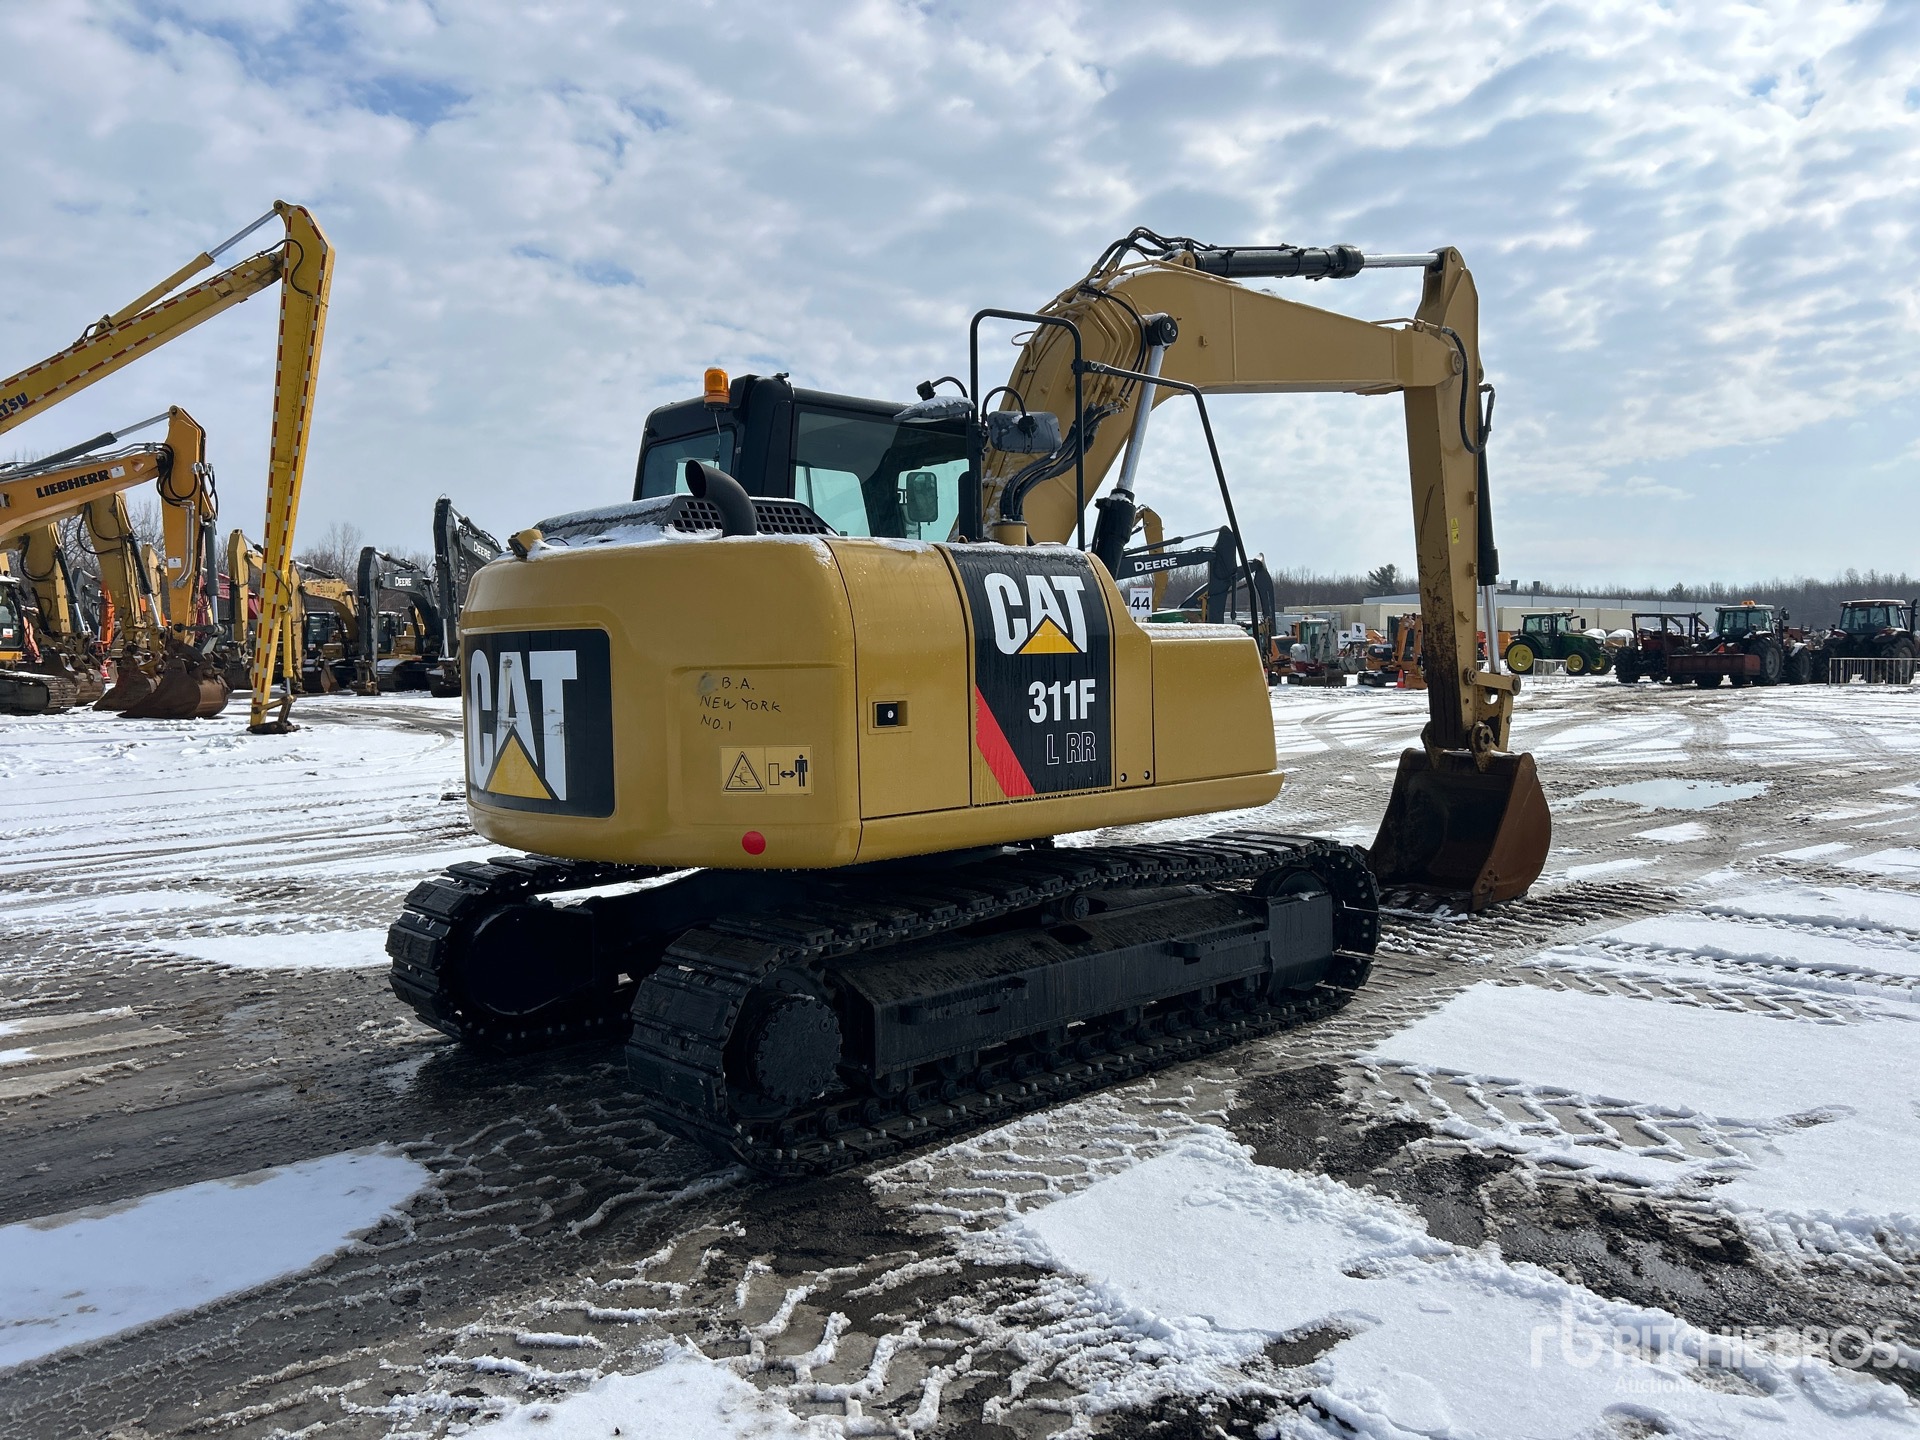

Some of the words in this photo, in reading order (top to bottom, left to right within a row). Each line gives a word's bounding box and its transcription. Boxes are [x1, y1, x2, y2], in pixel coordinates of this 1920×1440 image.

[0, 392, 28, 417] TSU
[36, 469, 110, 498] LIEBHERR
[473, 541, 491, 560] DEERE
[1133, 557, 1178, 572] DEERE
[394, 576, 412, 587] DEERE
[984, 572, 1088, 655] CAT
[1131, 596, 1151, 610] 44
[699, 695, 737, 710] NEW
[741, 698, 782, 713] YORK
[1028, 679, 1096, 724] 311F
[470, 649, 578, 801] CAT
[1046, 734, 1060, 766] L
[1066, 731, 1096, 764] RR
